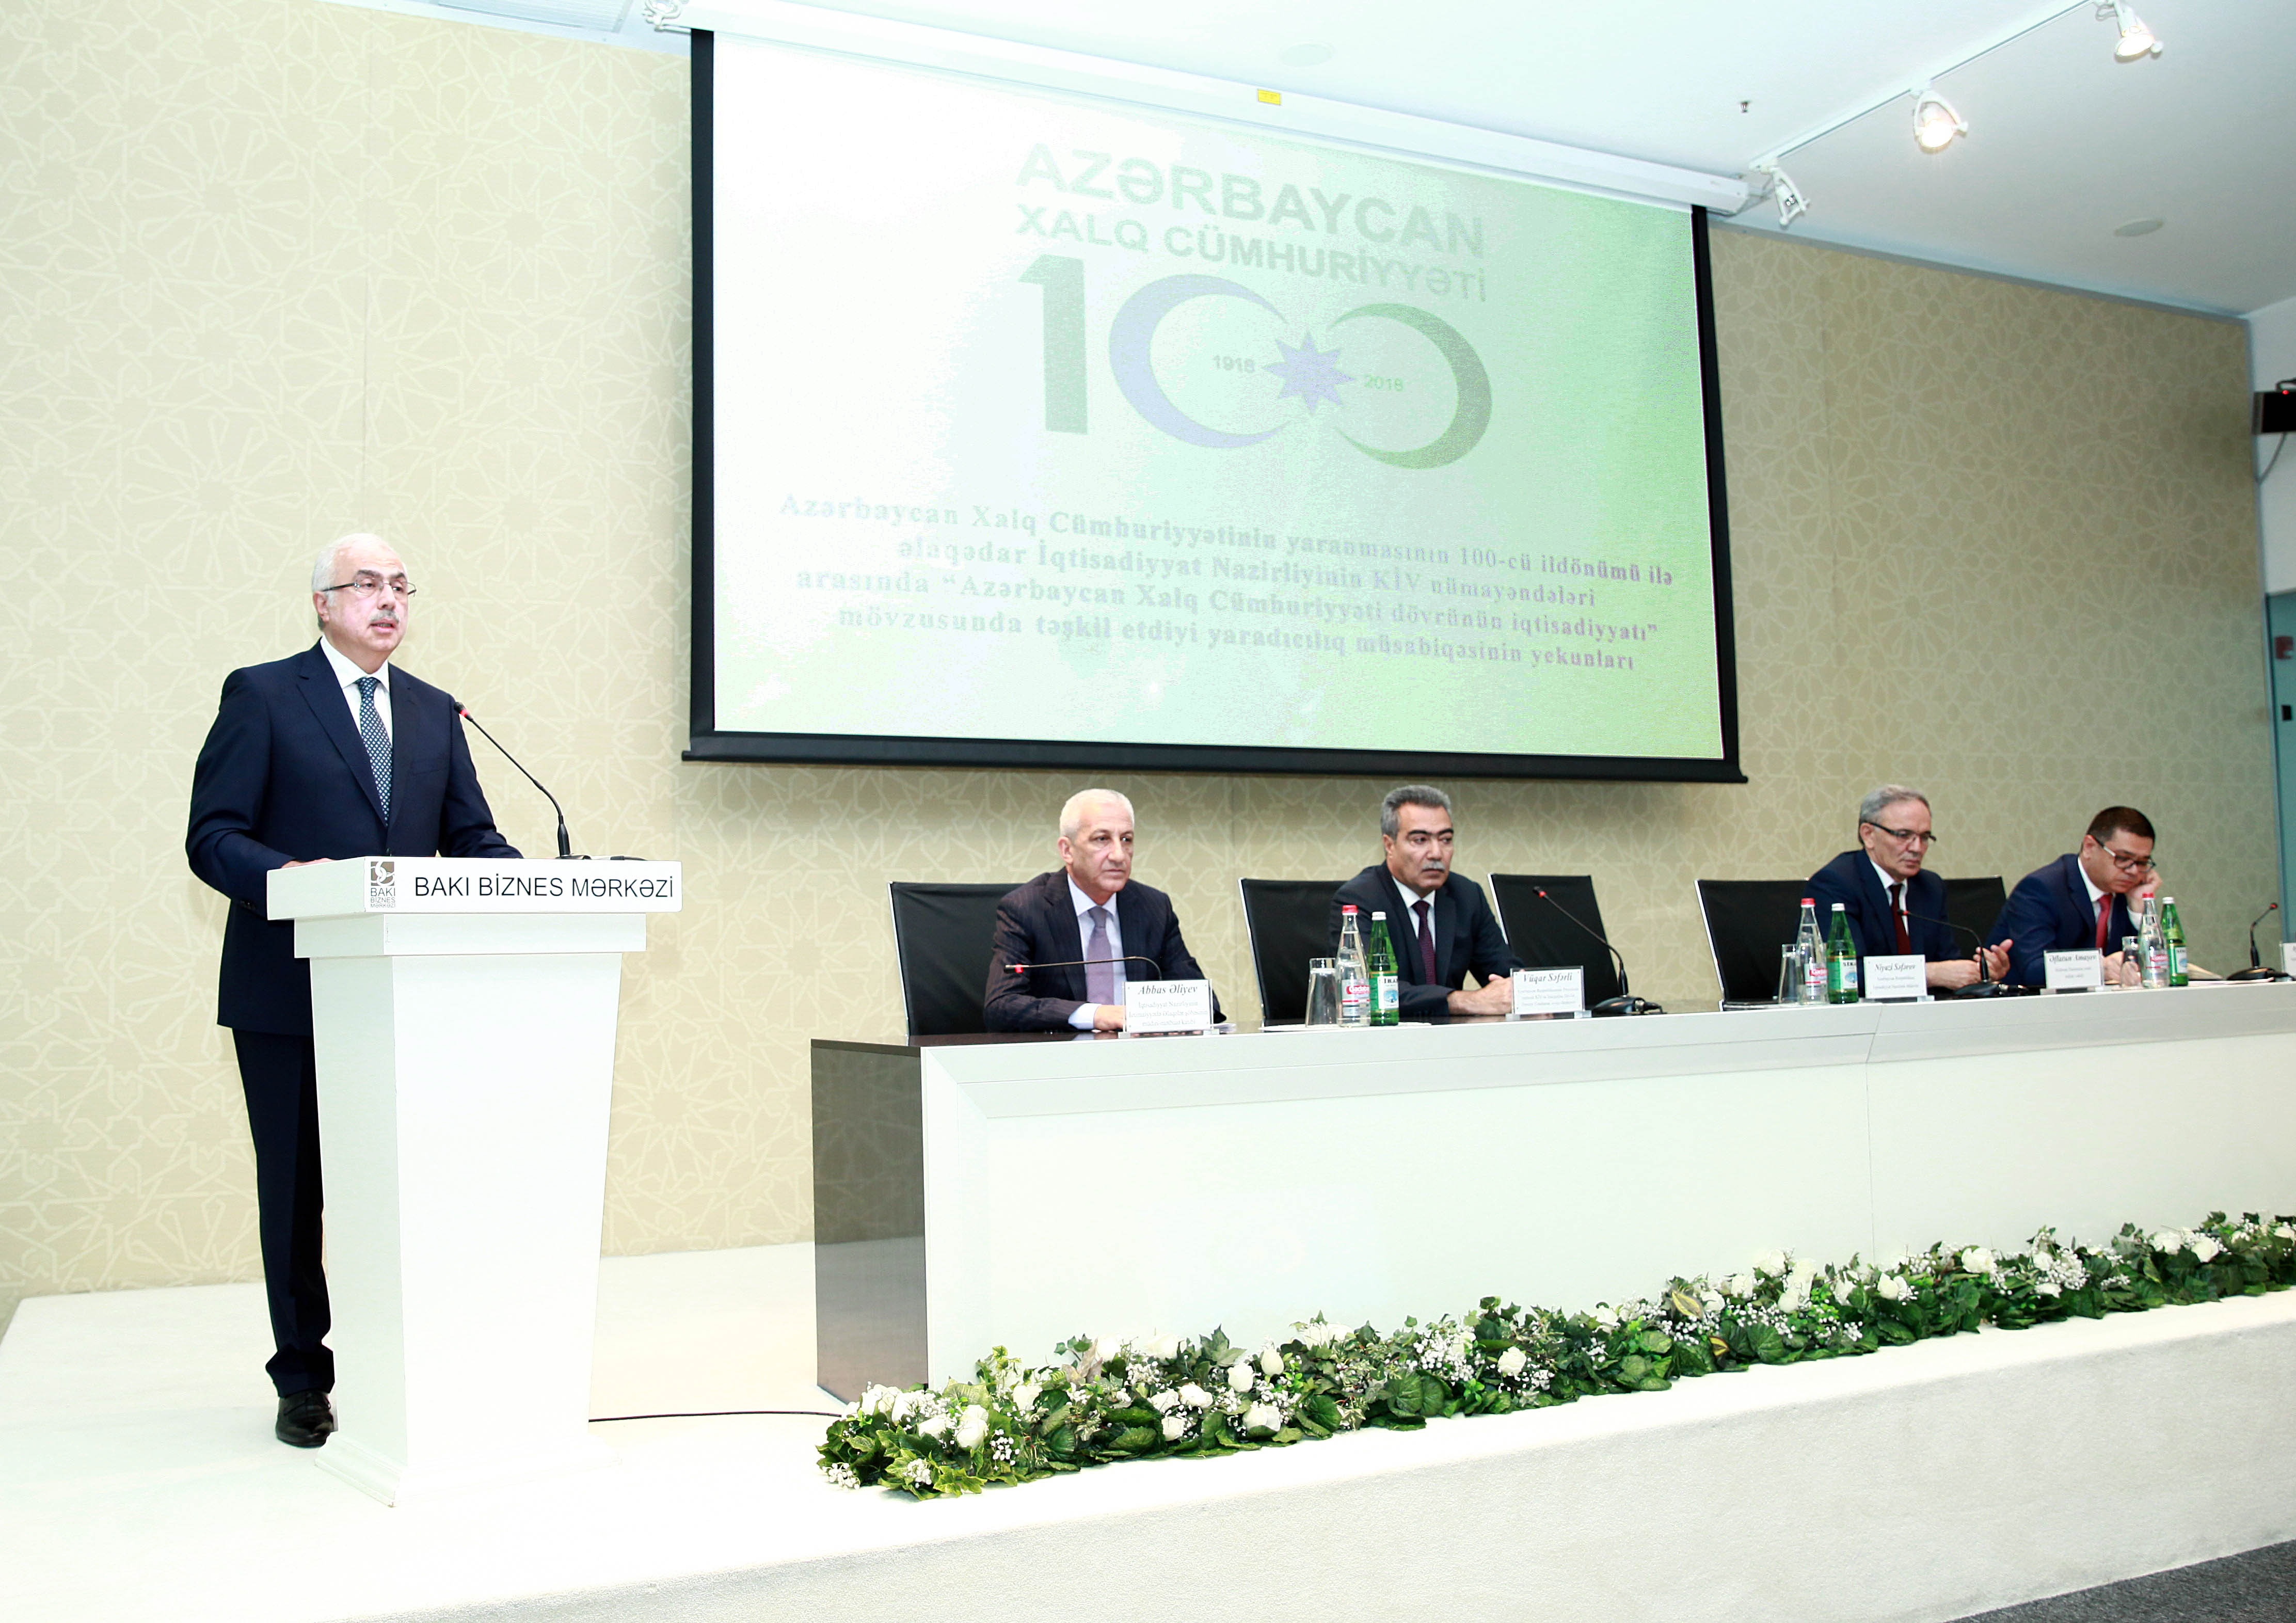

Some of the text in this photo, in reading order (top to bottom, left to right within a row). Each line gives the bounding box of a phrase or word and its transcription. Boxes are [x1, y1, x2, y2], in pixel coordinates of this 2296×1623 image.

[1016, 142, 1485, 260] AZƏRBAYCAN
[1015, 203, 1487, 302] XALQ CÜMHURİYYƏTİ
[1211, 354, 1255, 374] 1918
[1363, 373, 1404, 392] 2018
[779, 494, 1673, 586] Azərbaycan Xalq Cümhuriyyətinin yaranmasının 100-cü ildönümü ilə
[796, 569, 929, 593] arasında
[1135, 583, 1199, 615] Xalq
[1208, 588, 1381, 624] Cümhuriyyəti
[1393, 602, 1502, 630] dövrünün
[898, 535, 1596, 608] əlaqədar İqtisadiyyat Nazirliyinin KİV nümayəndələri
[838, 606, 1634, 671] mövzusunda təşkil etdiyi yaradıcılıq müsabiqəsinin yekunları
[371, 887, 395, 897] BAKI
[414, 873, 673, 898] BAKI BİZNES MƏRKƏZİ
[1138, 984, 1198, 996] Abbas Əliyev
